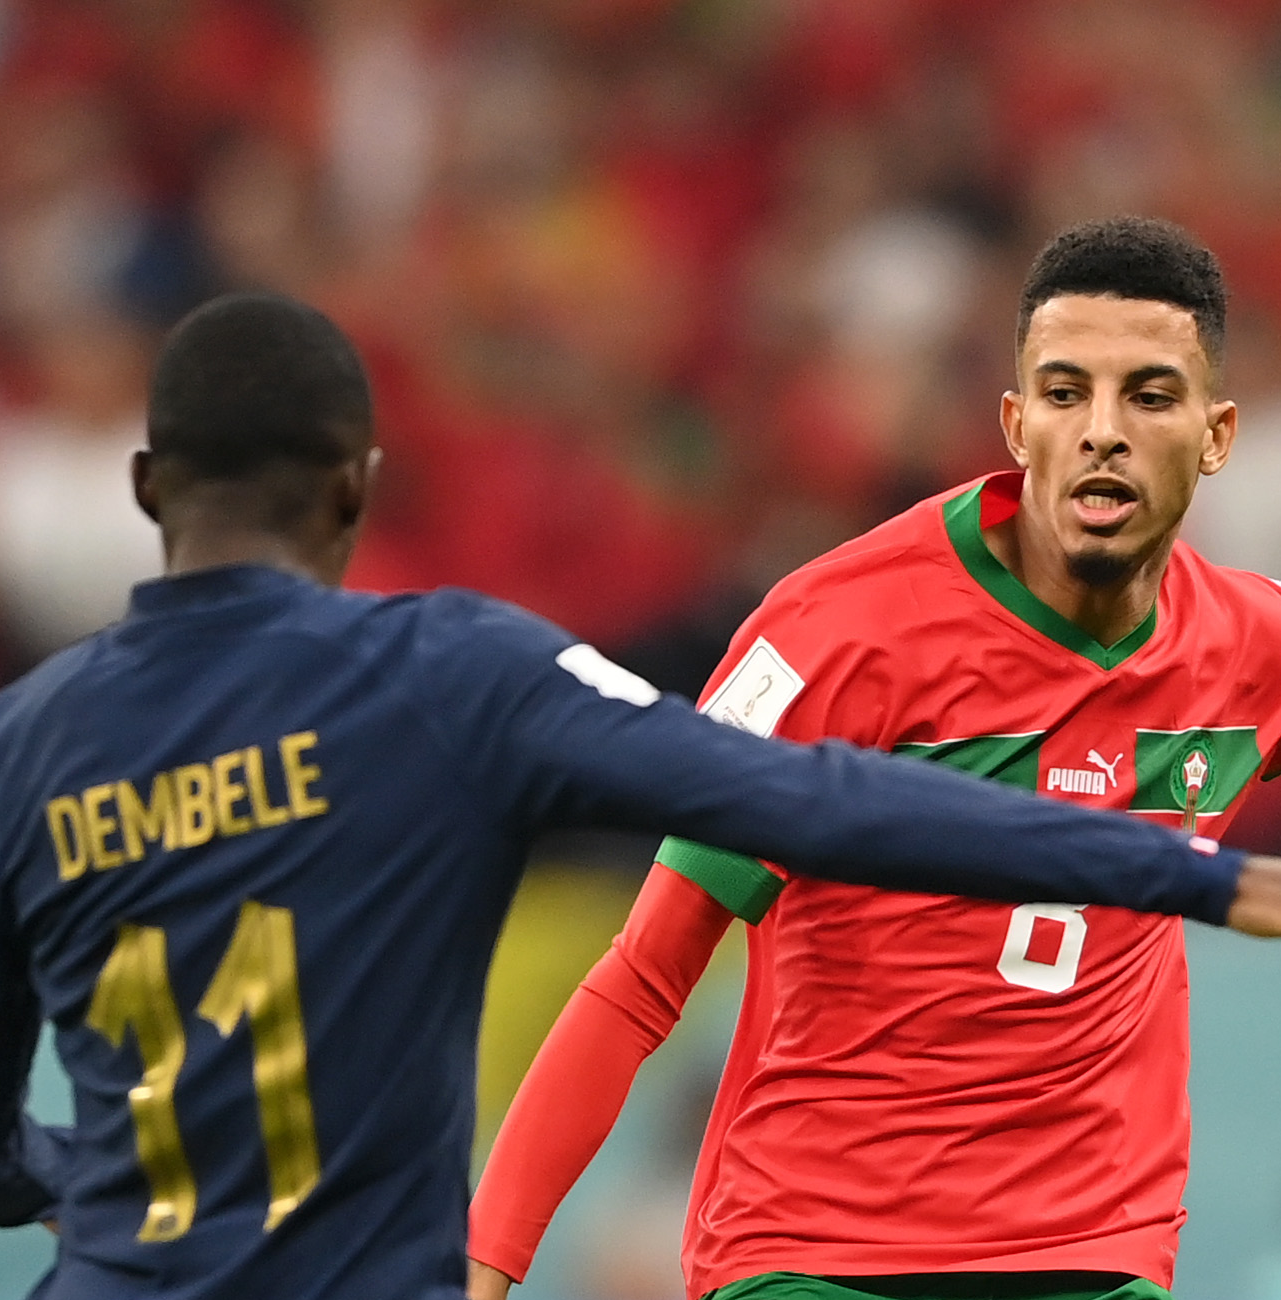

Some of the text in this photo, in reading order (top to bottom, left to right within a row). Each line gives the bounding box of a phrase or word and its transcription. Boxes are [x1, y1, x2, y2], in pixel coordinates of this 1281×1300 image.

[45, 729, 331, 883] DEMBELE
[1046, 766, 1106, 796] PUMA
[84, 899, 320, 1243] 11
